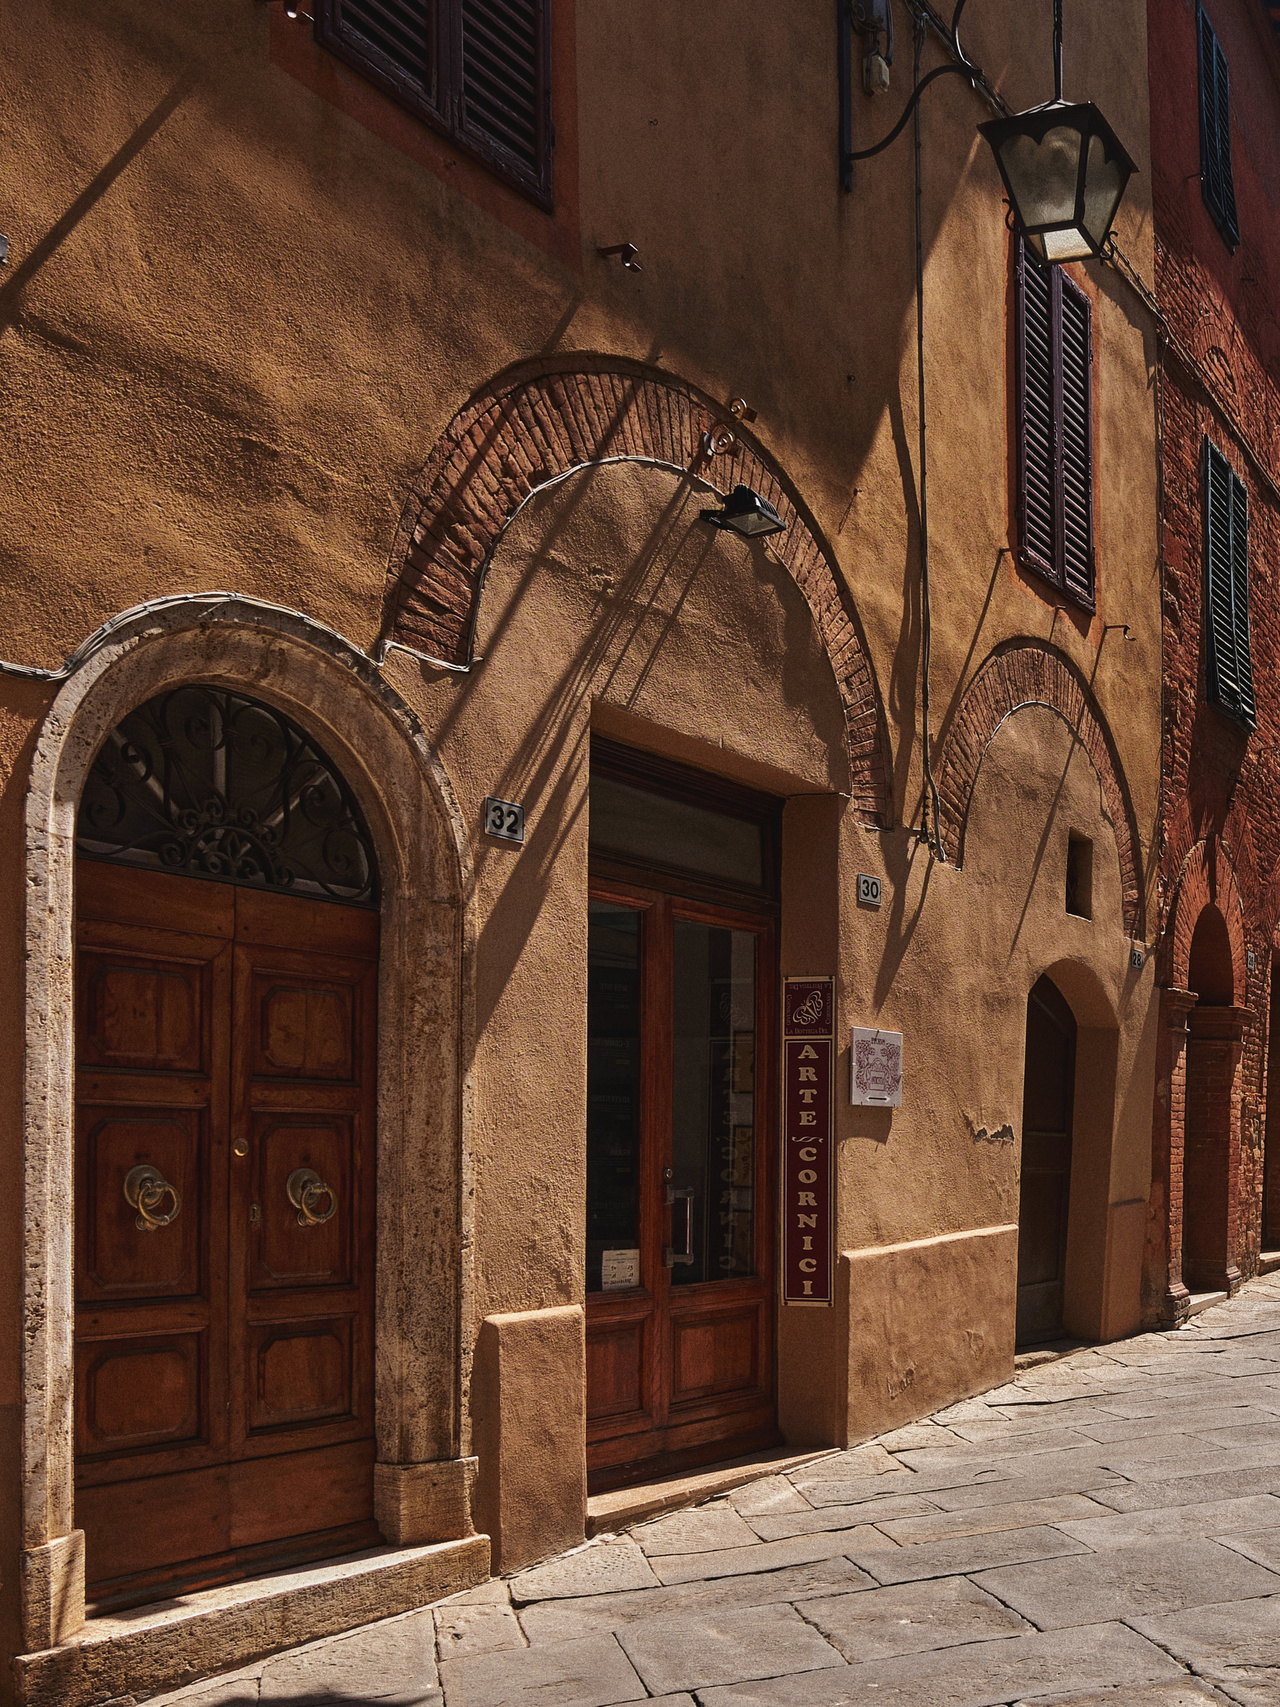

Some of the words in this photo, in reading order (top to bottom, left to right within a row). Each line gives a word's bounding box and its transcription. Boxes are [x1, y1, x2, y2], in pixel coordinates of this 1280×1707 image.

[491, 805, 519, 834] 32
[862, 879, 879, 899] 30
[1132, 952, 1141, 966] 28
[797, 1044, 819, 1126] ARTE
[797, 1147, 819, 1295] CORNICI
